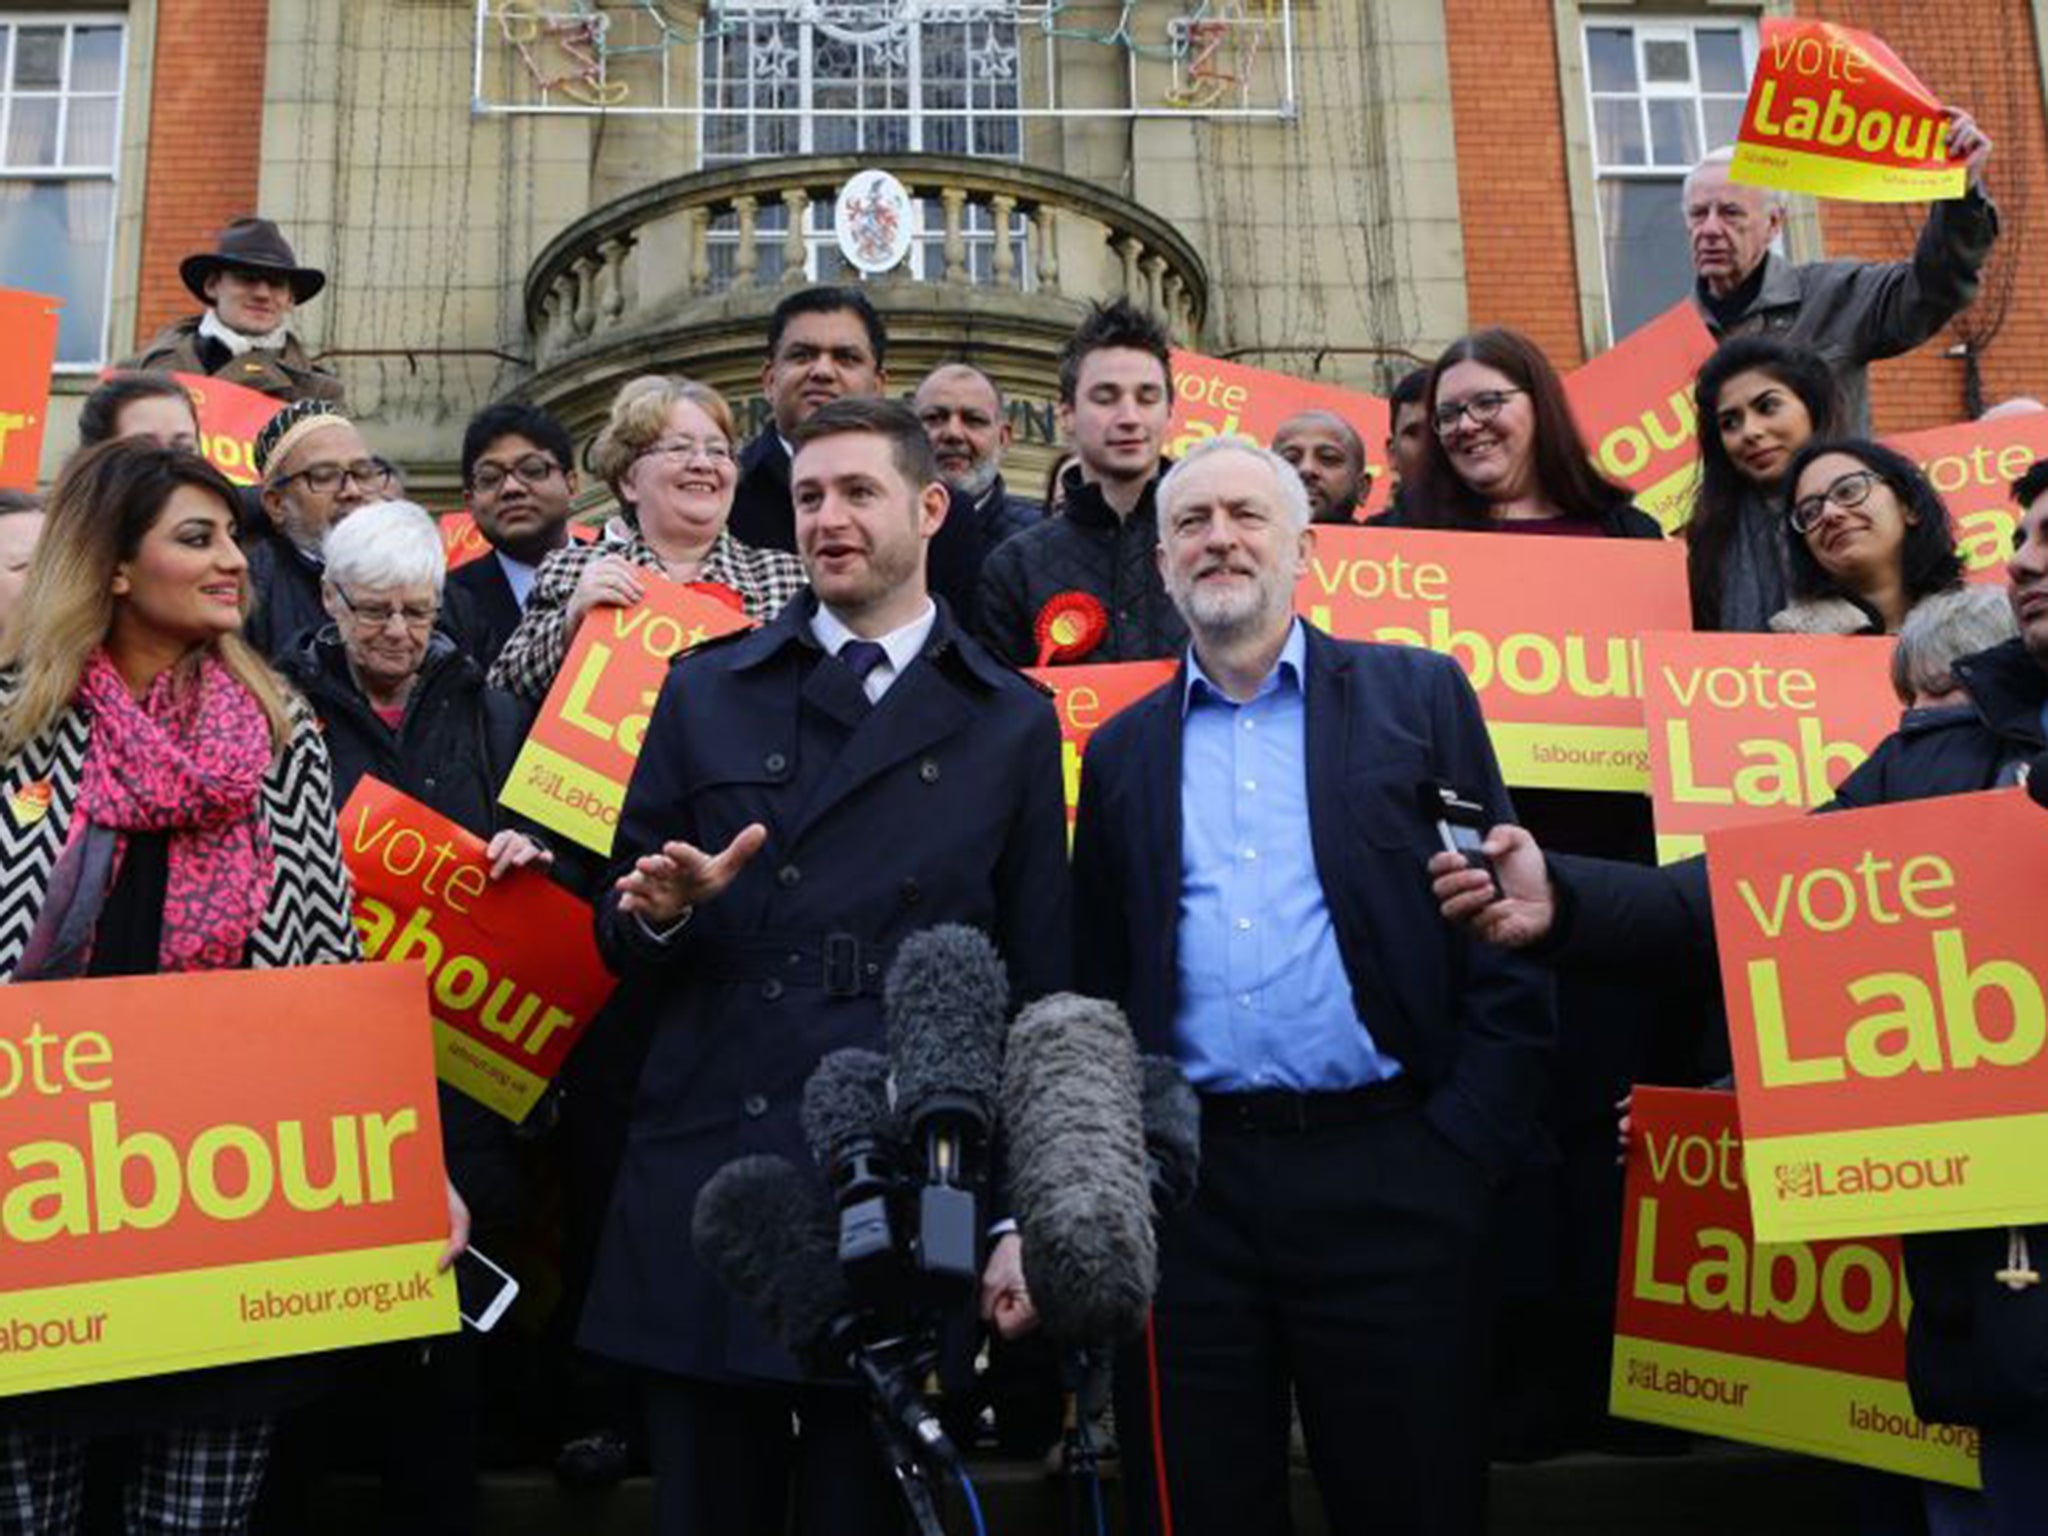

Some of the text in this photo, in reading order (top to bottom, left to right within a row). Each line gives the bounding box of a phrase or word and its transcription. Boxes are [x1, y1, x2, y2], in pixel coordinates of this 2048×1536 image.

[1771, 33, 1867, 84] vote
[1589, 382, 1698, 480] ou
[1920, 444, 2035, 494] ote
[1312, 554, 1448, 601] vote
[1311, 605, 1643, 698] bou
[1661, 661, 1816, 710] vote
[353, 806, 487, 914] vote
[1735, 851, 1956, 938] vote
[1747, 928, 2046, 1088] Lab
[2, 1101, 418, 1243] abour
[1645, 1126, 1748, 1190] vot
[1813, 1154, 1970, 1196] Labour
[239, 1272, 433, 1323] labour.org.uk
[1634, 1197, 1914, 1335] Labo
[1652, 1364, 1749, 1407] Labour
